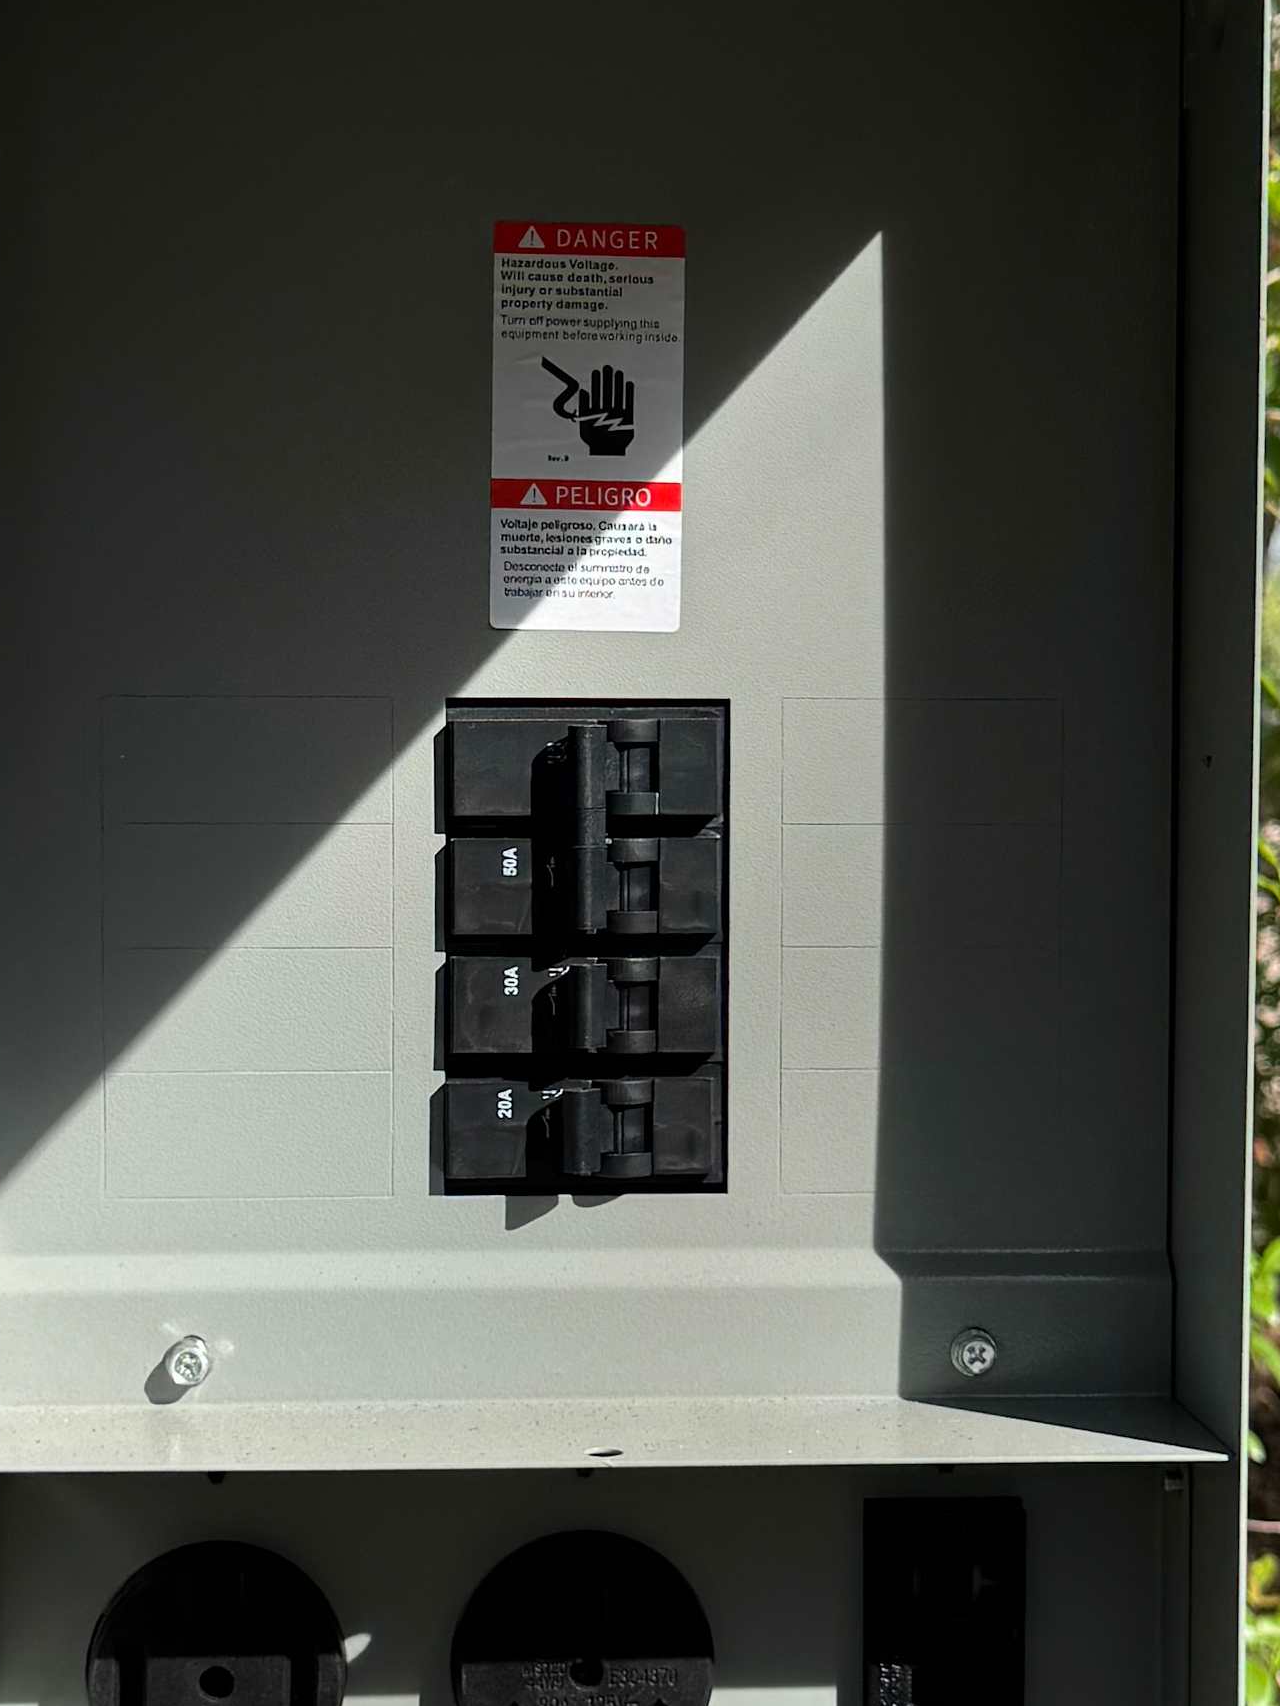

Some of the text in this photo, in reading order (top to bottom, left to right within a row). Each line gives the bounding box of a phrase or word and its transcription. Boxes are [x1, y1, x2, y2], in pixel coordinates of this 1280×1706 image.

[557, 229, 658, 250] DANGER
[501, 258, 619, 272] Hazardous Voltage.
[501, 271, 654, 284] Will cause death, serious
[501, 284, 623, 297] injury or substantial
[501, 299, 608, 312] property damage.
[501, 315, 660, 330] Turn off power supplying this
[501, 329, 681, 343] equipment before working inside.
[556, 486, 652, 507] PELIGRO
[500, 519, 538, 532] Voltaje
[541, 520, 596, 533] peligroso.
[648, 522, 657, 531] la
[500, 533, 544, 544] muerte,
[546, 533, 593, 544] lesiones
[594, 536, 632, 545] graves
[646, 536, 672, 545] daño
[500, 545, 647, 557] substancial a la propiedad.
[504, 561, 650, 574] Desconecte el suministro de
[545, 576, 552, 585] a
[553, 576, 577, 585] este
[579, 577, 616, 587] equipo
[618, 578, 647, 586] antes
[649, 577, 664, 587] de
[504, 587, 544, 599] trabajar
[546, 589, 560, 598] en
[562, 590, 575, 598] su
[502, 847, 518, 877] 50A
[504, 966, 519, 997] 30A
[497, 1089, 513, 1119] 20A
